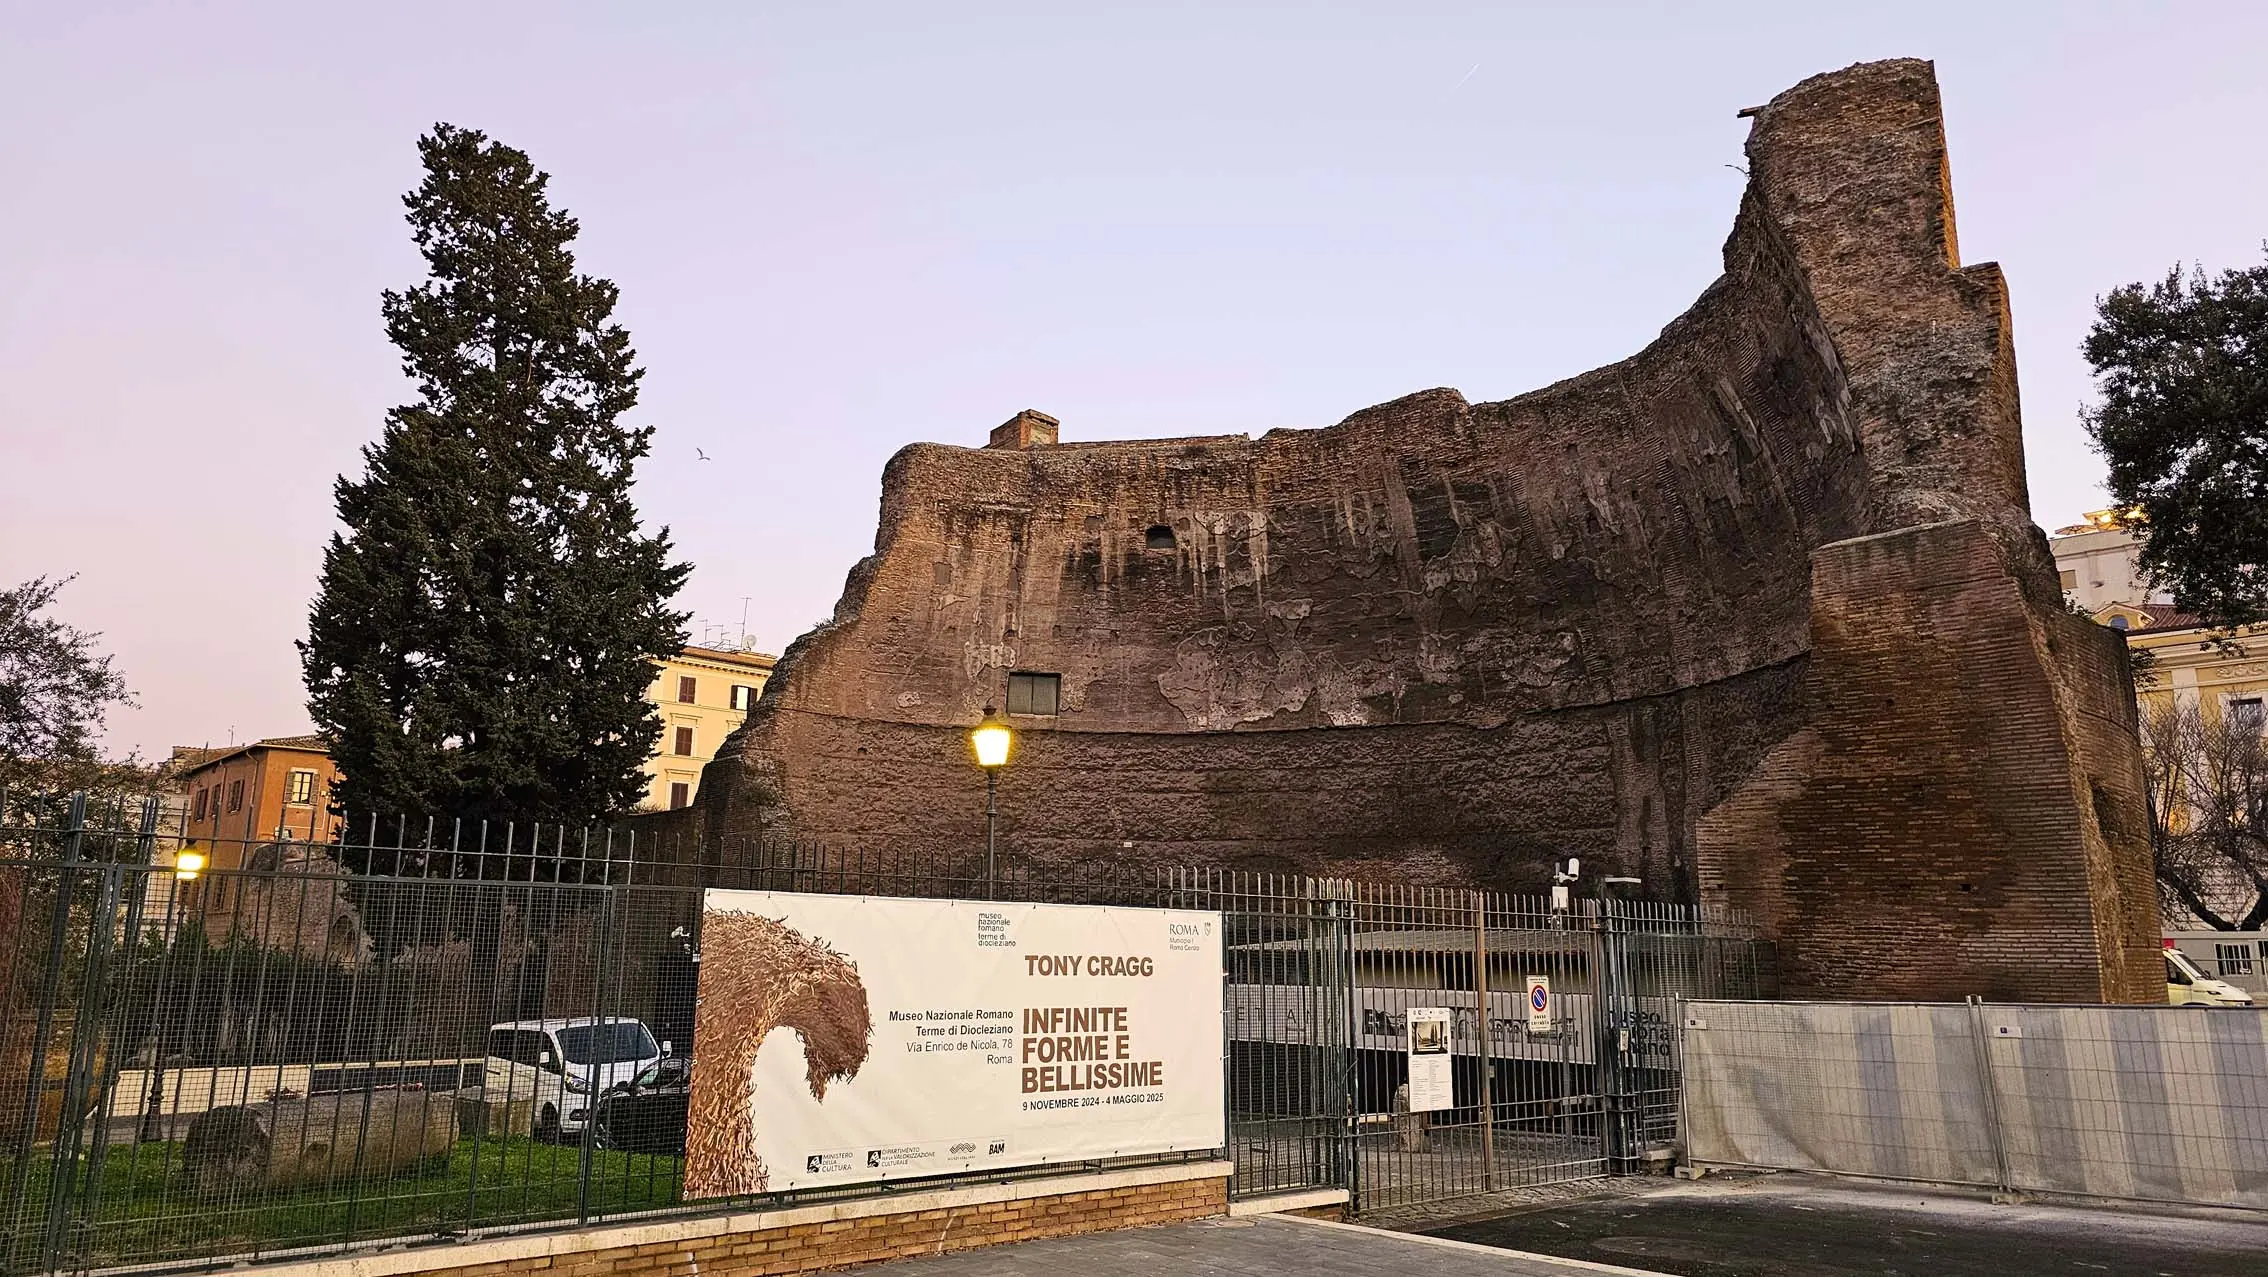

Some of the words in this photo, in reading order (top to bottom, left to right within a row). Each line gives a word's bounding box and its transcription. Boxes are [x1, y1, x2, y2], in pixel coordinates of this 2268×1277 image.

[1169, 923, 1199, 935] ROMA
[1025, 955, 1082, 976] TONY
[1087, 955, 1153, 977] CRAGG
[889, 1011, 923, 1021] Museo
[926, 1010, 973, 1021] Nazionale
[976, 1009, 1014, 1020] Romano
[1023, 1007, 1128, 1034] INFINITE
[916, 1026, 945, 1036] Terme
[948, 1025, 958, 1035] di
[960, 1024, 1014, 1035] Diocleziano
[907, 1042, 922, 1052] Via
[925, 1041, 954, 1052] Enrico
[957, 1041, 968, 1051] de
[971, 1039, 1000, 1050] Nicola,
[1002, 1038, 1013, 1049] 78
[1022, 1035, 1109, 1064] FORME
[1116, 1035, 1130, 1060] E
[987, 1054, 1013, 1065] Roma
[1021, 1061, 1163, 1094] BELLISSIME
[1022, 1101, 1028, 1111] 9
[1030, 1097, 1079, 1110] NOVEMBRE
[1081, 1096, 1100, 1107] 2024
[1105, 1095, 1111, 1105] 4
[1112, 1094, 1145, 1105] MAGGIO
[1146, 1092, 1164, 1103] 2025
[988, 1143, 1005, 1155] BAM
[823, 1152, 853, 1160] MINISTERO
[822, 1164, 852, 1172] CULTURA
